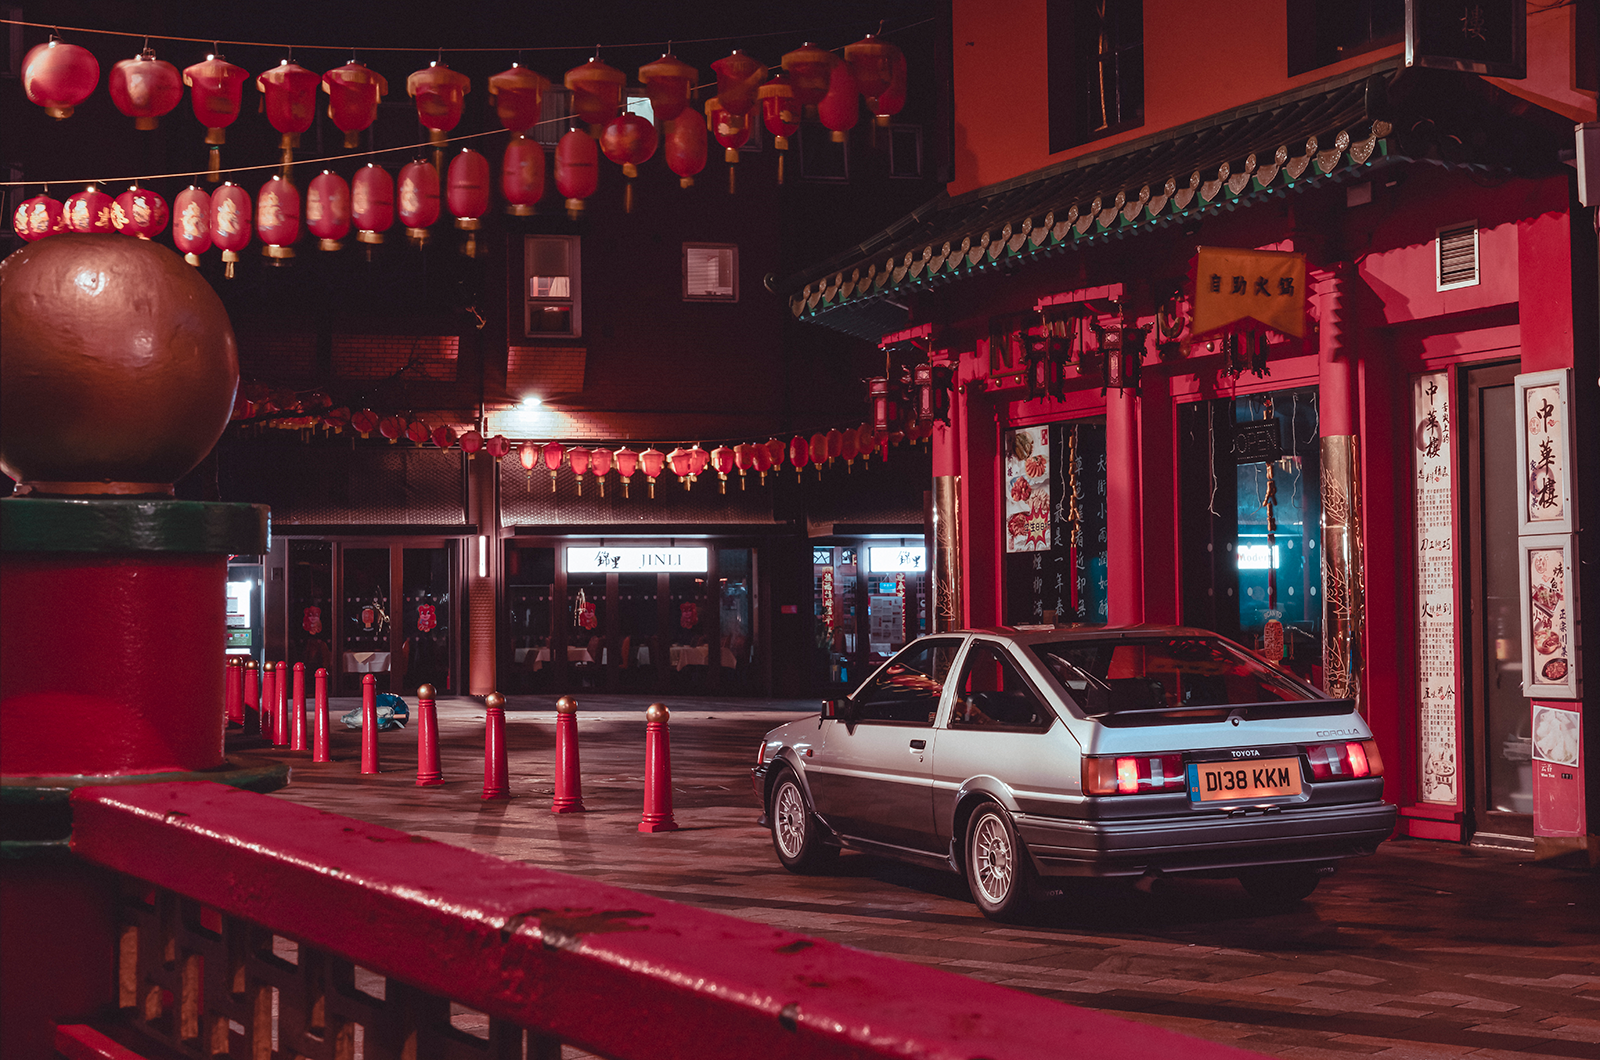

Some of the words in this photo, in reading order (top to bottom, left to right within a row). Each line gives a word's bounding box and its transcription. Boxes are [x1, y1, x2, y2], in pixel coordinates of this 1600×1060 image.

[1536, 398, 1559, 508] 中華樓
[639, 553, 682, 569] JINLI
[1316, 728, 1360, 737] COROLLA
[1231, 749, 1260, 758] TOYOTA
[1205, 770, 1248, 792] D138
[1252, 767, 1290, 789] KKM
